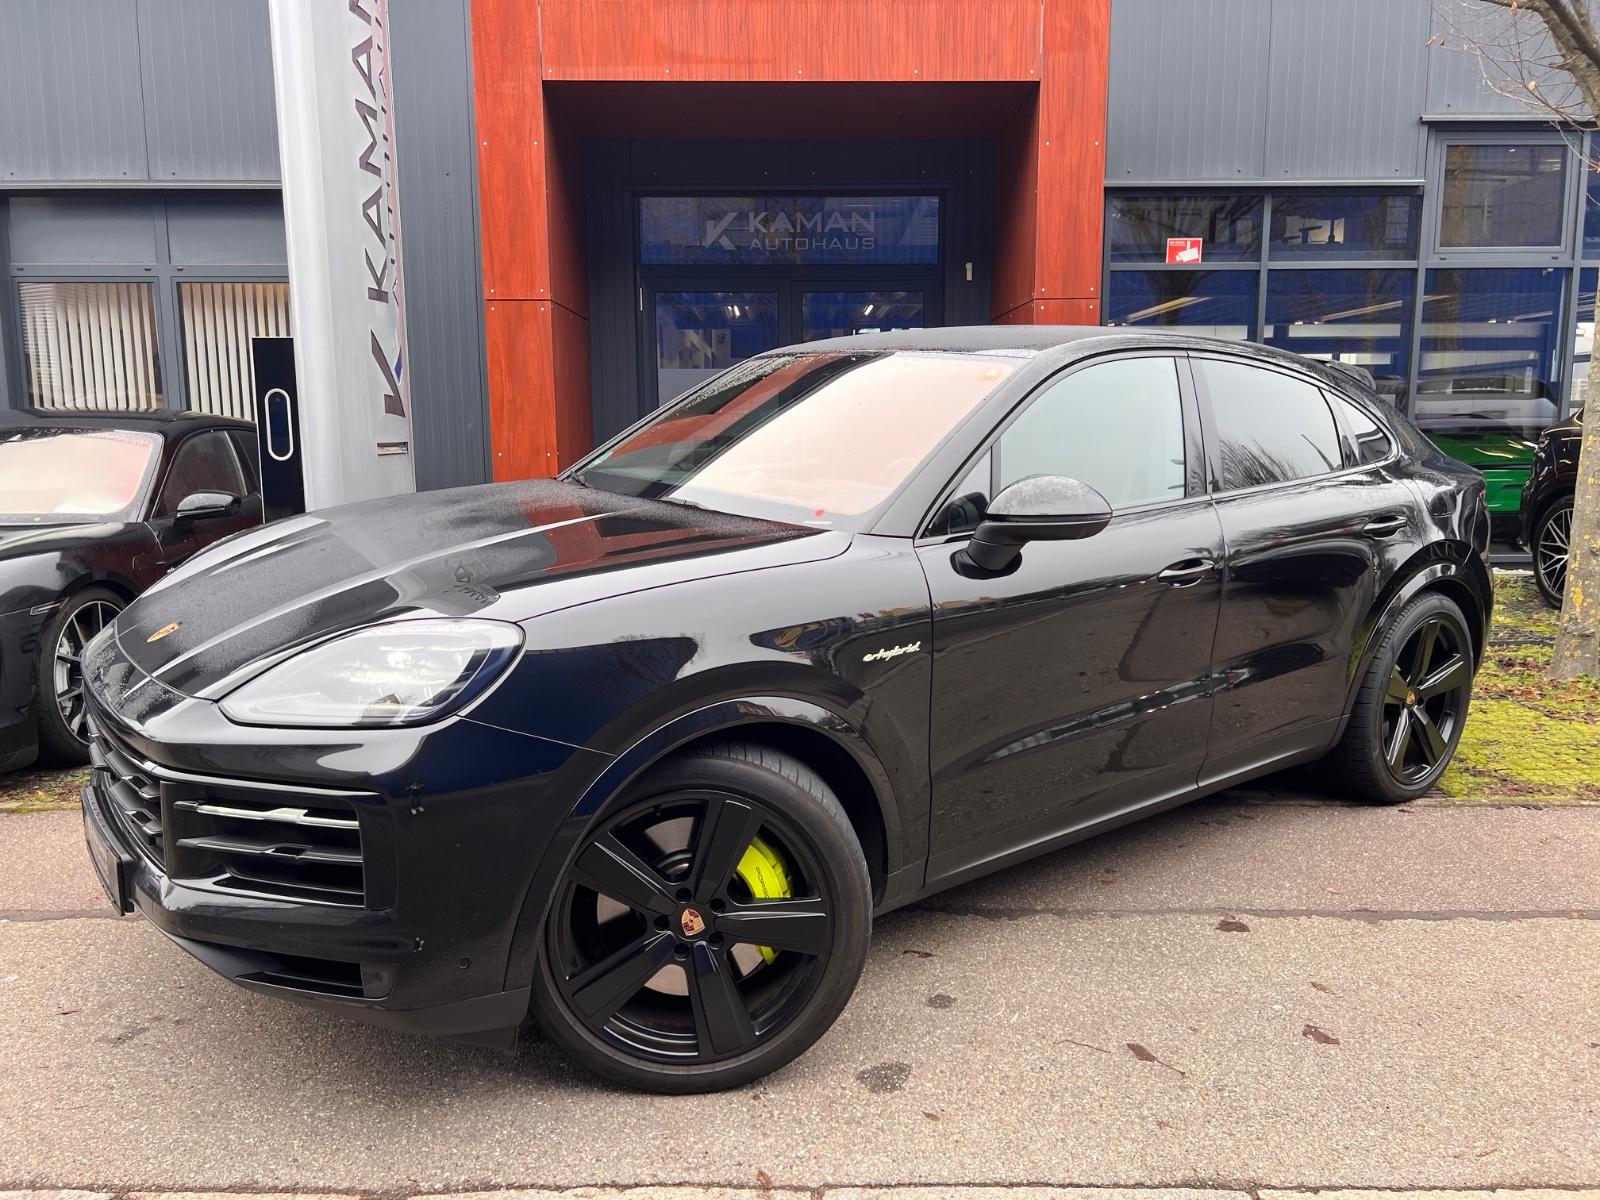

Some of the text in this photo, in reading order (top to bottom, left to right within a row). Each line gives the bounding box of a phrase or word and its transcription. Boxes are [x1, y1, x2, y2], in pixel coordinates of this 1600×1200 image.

[749, 211, 875, 233] KAMAN
[751, 237, 875, 250] AUTOHAUS
[862, 641, 921, 662] e-hybrid
